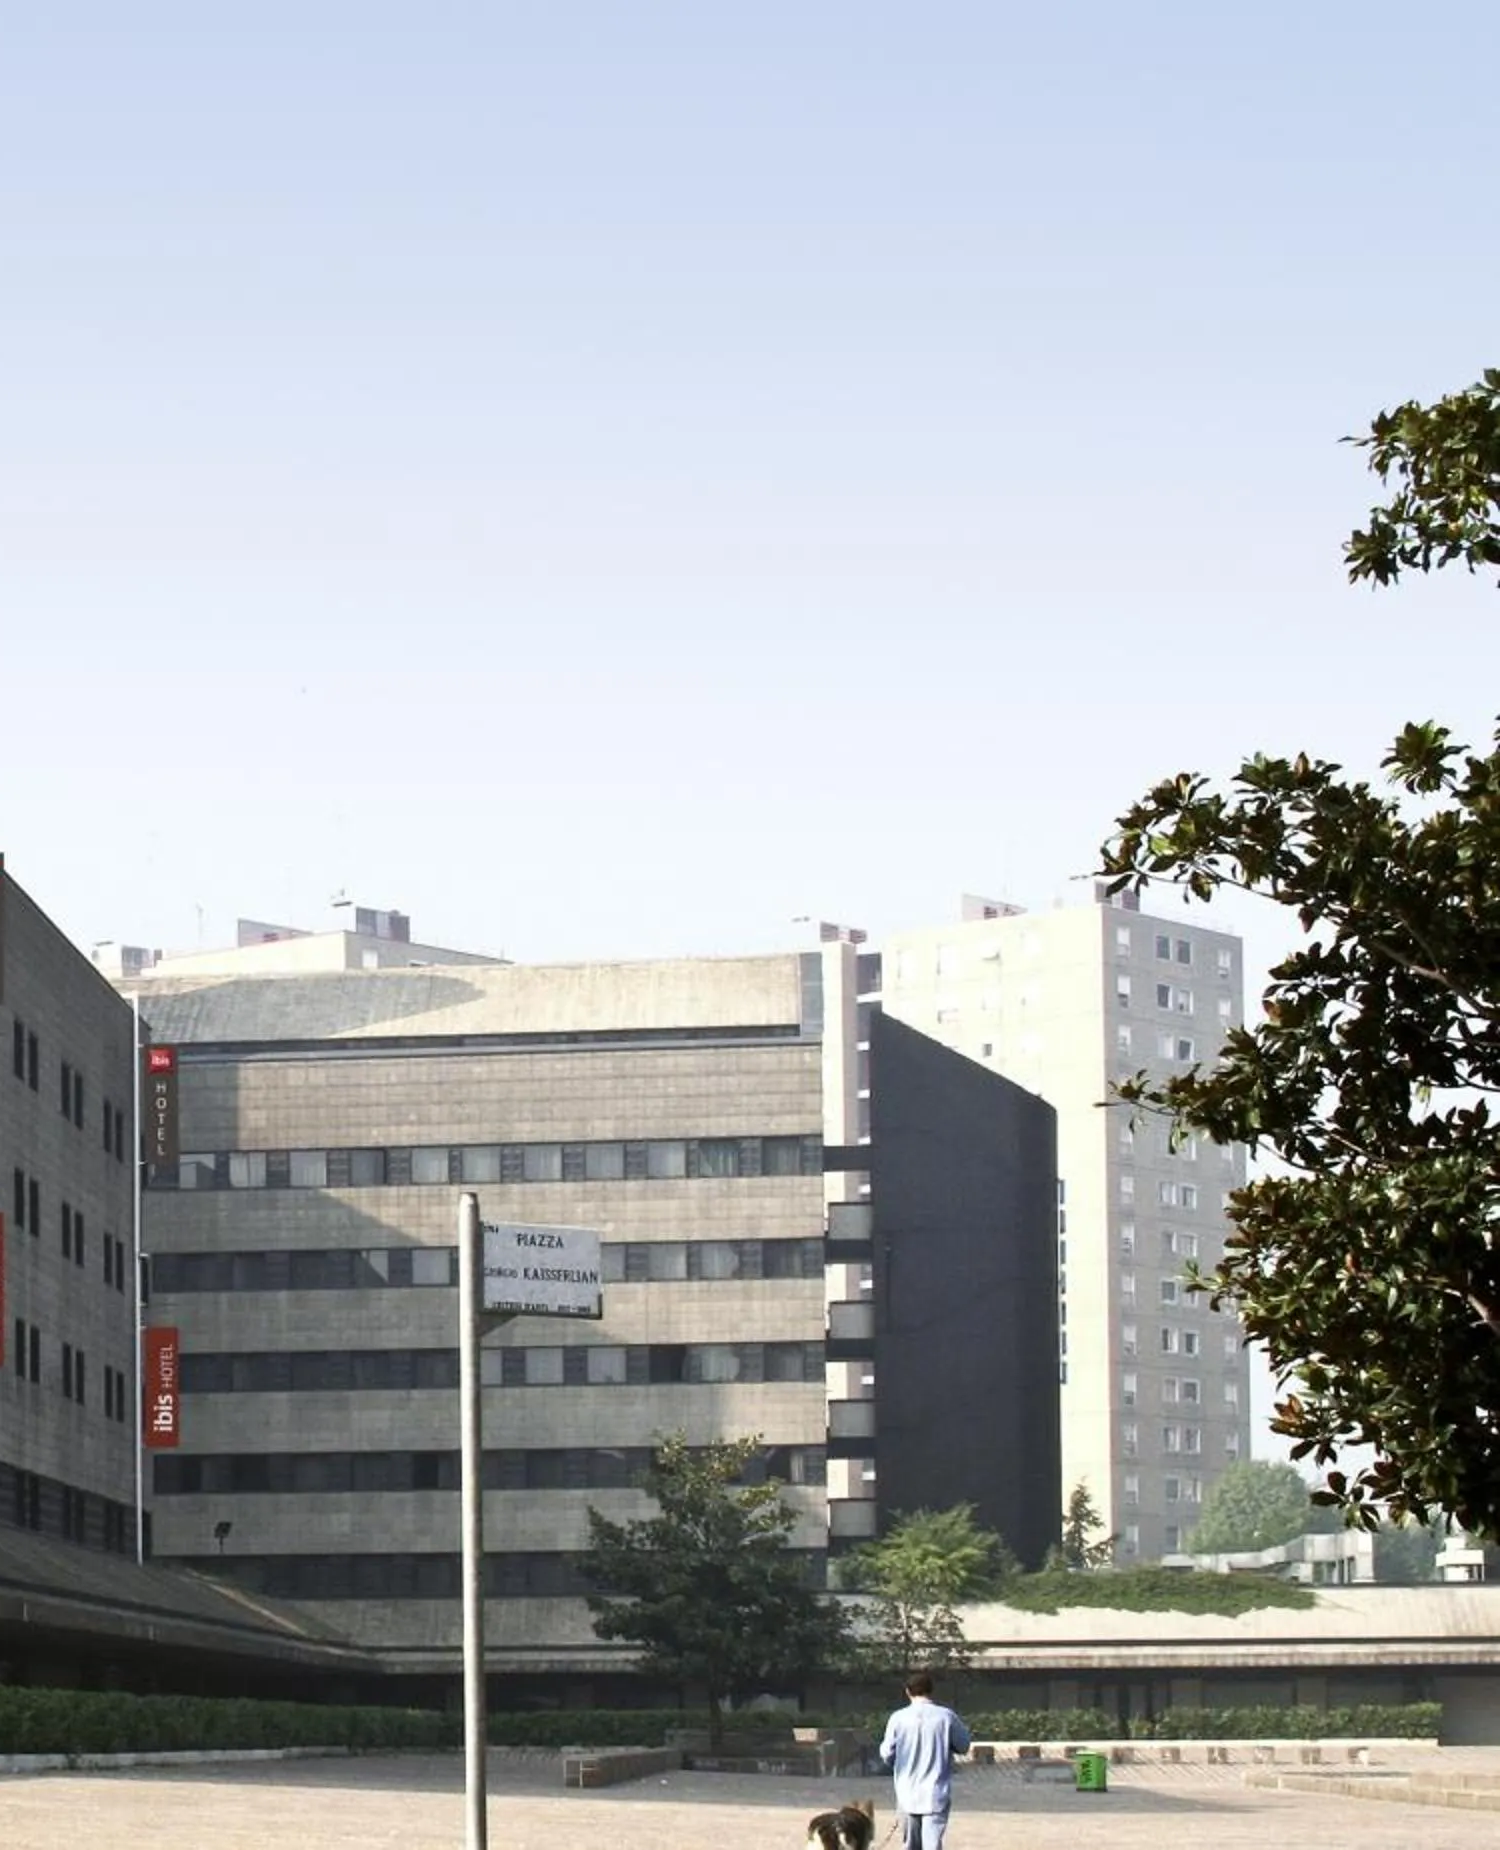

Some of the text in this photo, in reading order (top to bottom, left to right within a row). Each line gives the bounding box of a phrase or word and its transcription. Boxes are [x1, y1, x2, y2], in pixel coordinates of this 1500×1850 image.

[155, 1082, 167, 1156] HOTEL
[517, 1233, 564, 1249] PIAZZA
[153, 1344, 173, 1432] ibis HOTEL
